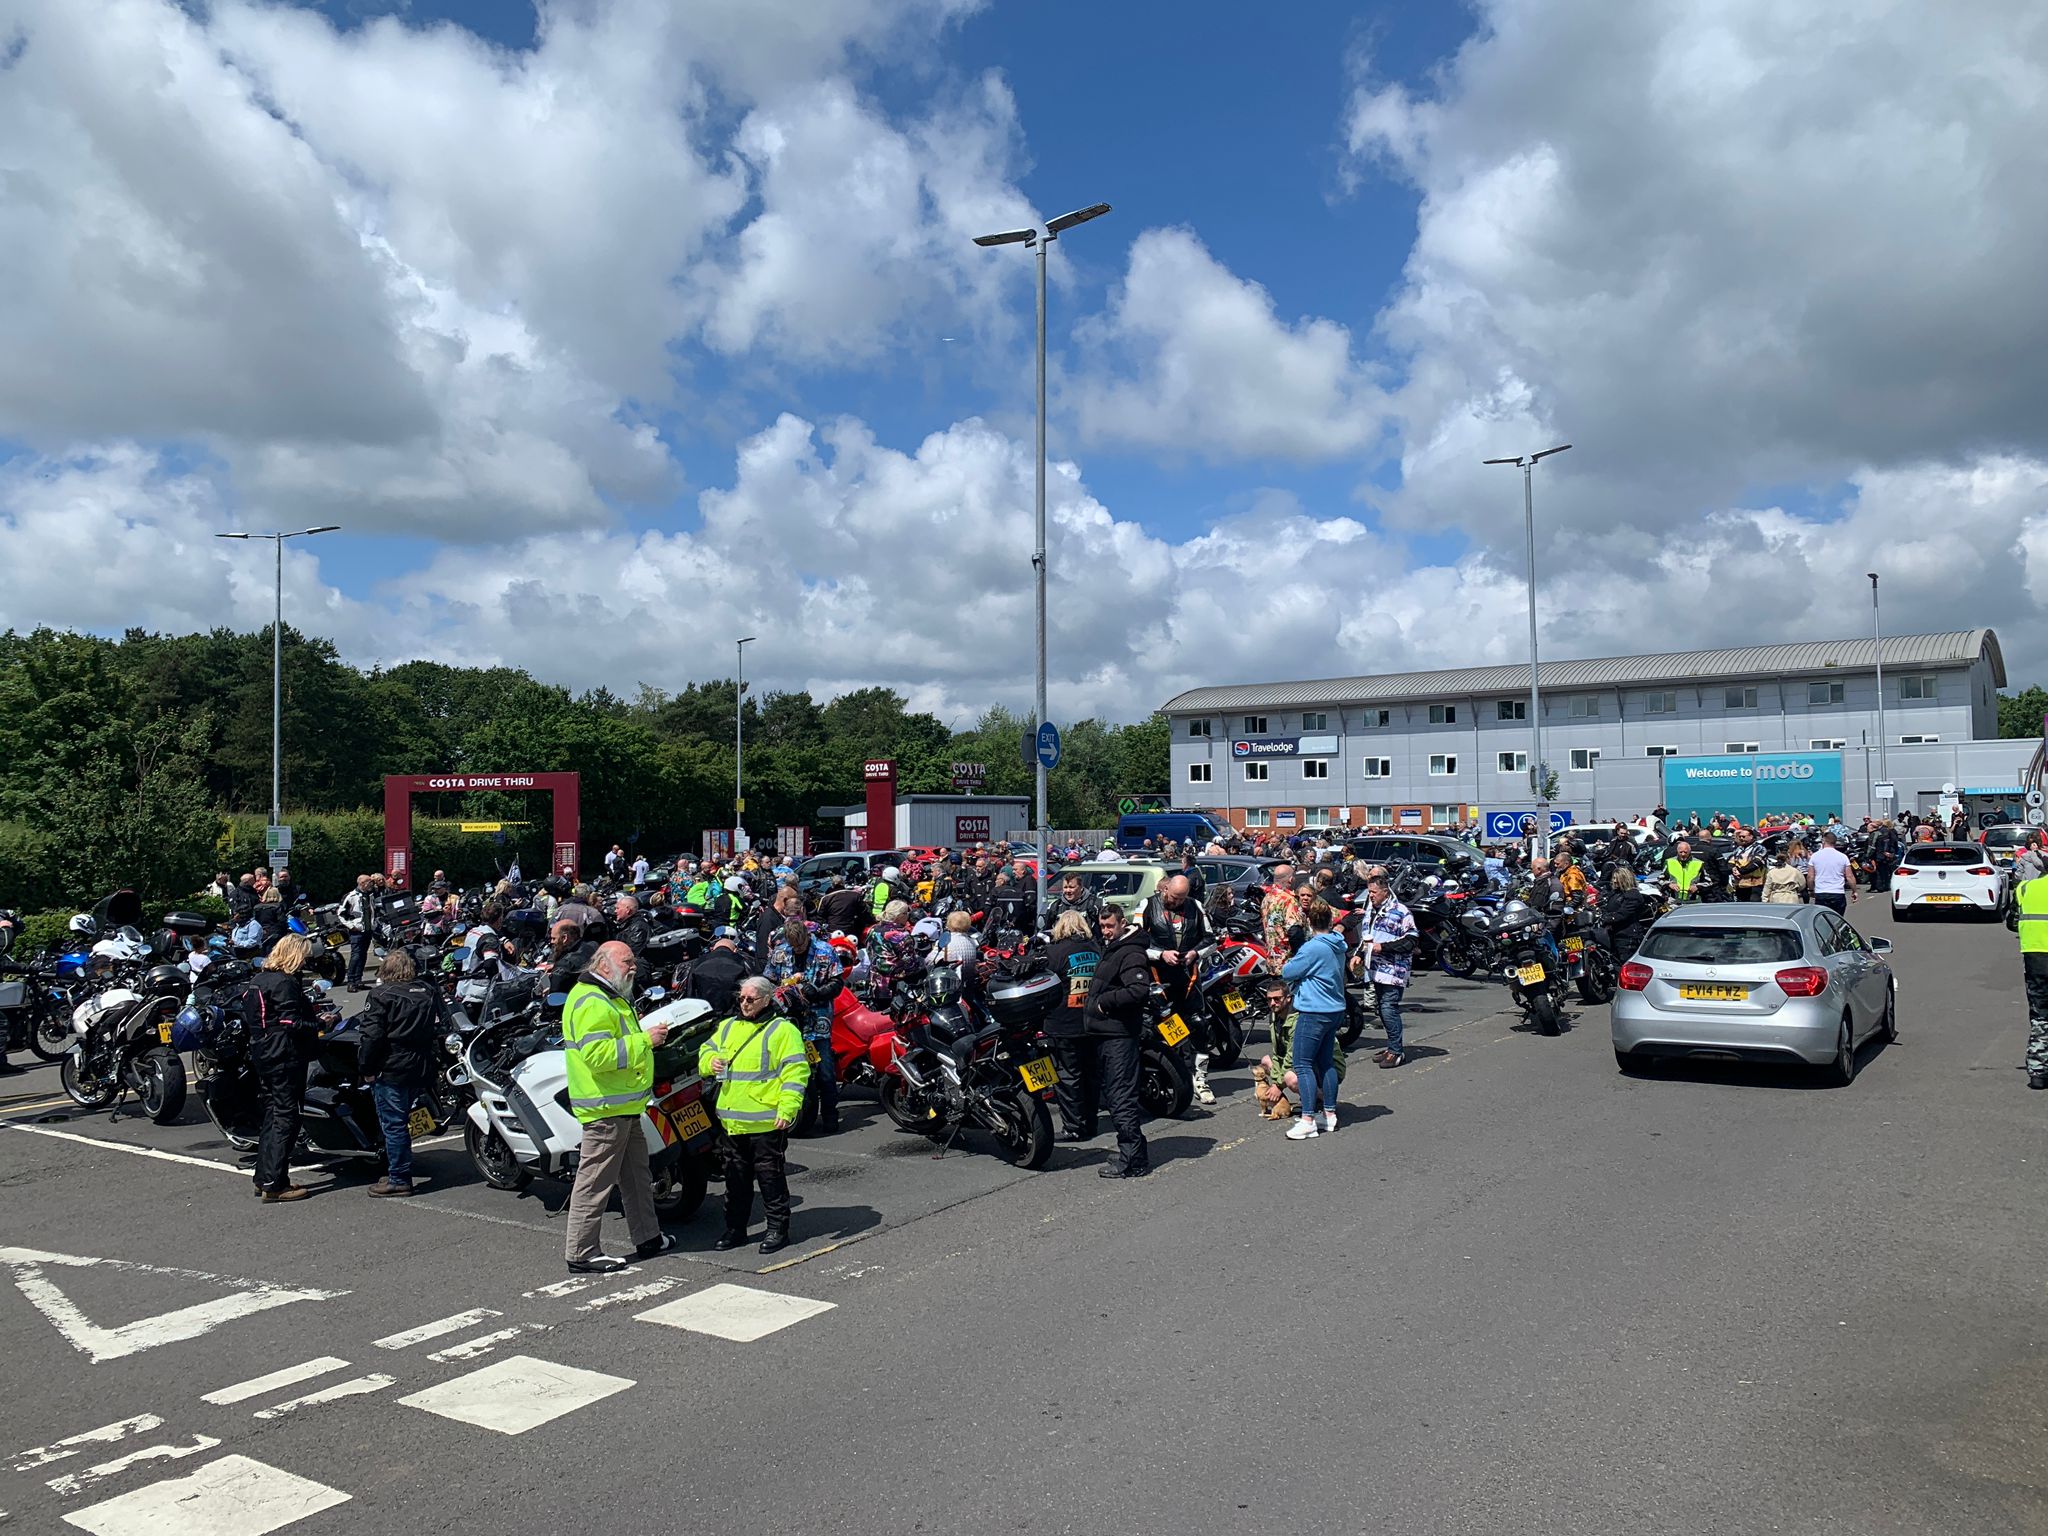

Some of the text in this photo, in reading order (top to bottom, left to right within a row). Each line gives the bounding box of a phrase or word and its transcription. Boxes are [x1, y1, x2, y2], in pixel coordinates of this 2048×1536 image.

[1041, 733, 1055, 743] EXIT
[1251, 742, 1294, 753] Travelodge
[865, 763, 889, 772] COSTA
[953, 763, 986, 775] COSTA
[1686, 761, 1814, 779] Welcome to moto
[429, 779, 465, 788] COSTA
[469, 778, 501, 786] DRIVE
[504, 777, 533, 786] THRU
[959, 820, 988, 832] COSTA
[1519, 965, 1541, 975] MA09
[1523, 973, 1541, 982] MXH
[1075, 981, 1081, 989] A
[1687, 985, 1741, 997] FV14 FWZ
[1168, 1026, 1186, 1041] TXE
[1026, 1059, 1048, 1076] KP11
[1030, 1072, 1053, 1087] RMU
[673, 1102, 703, 1125] MH02
[410, 1121, 430, 1137] ZSW
[684, 1119, 707, 1137] ODL
